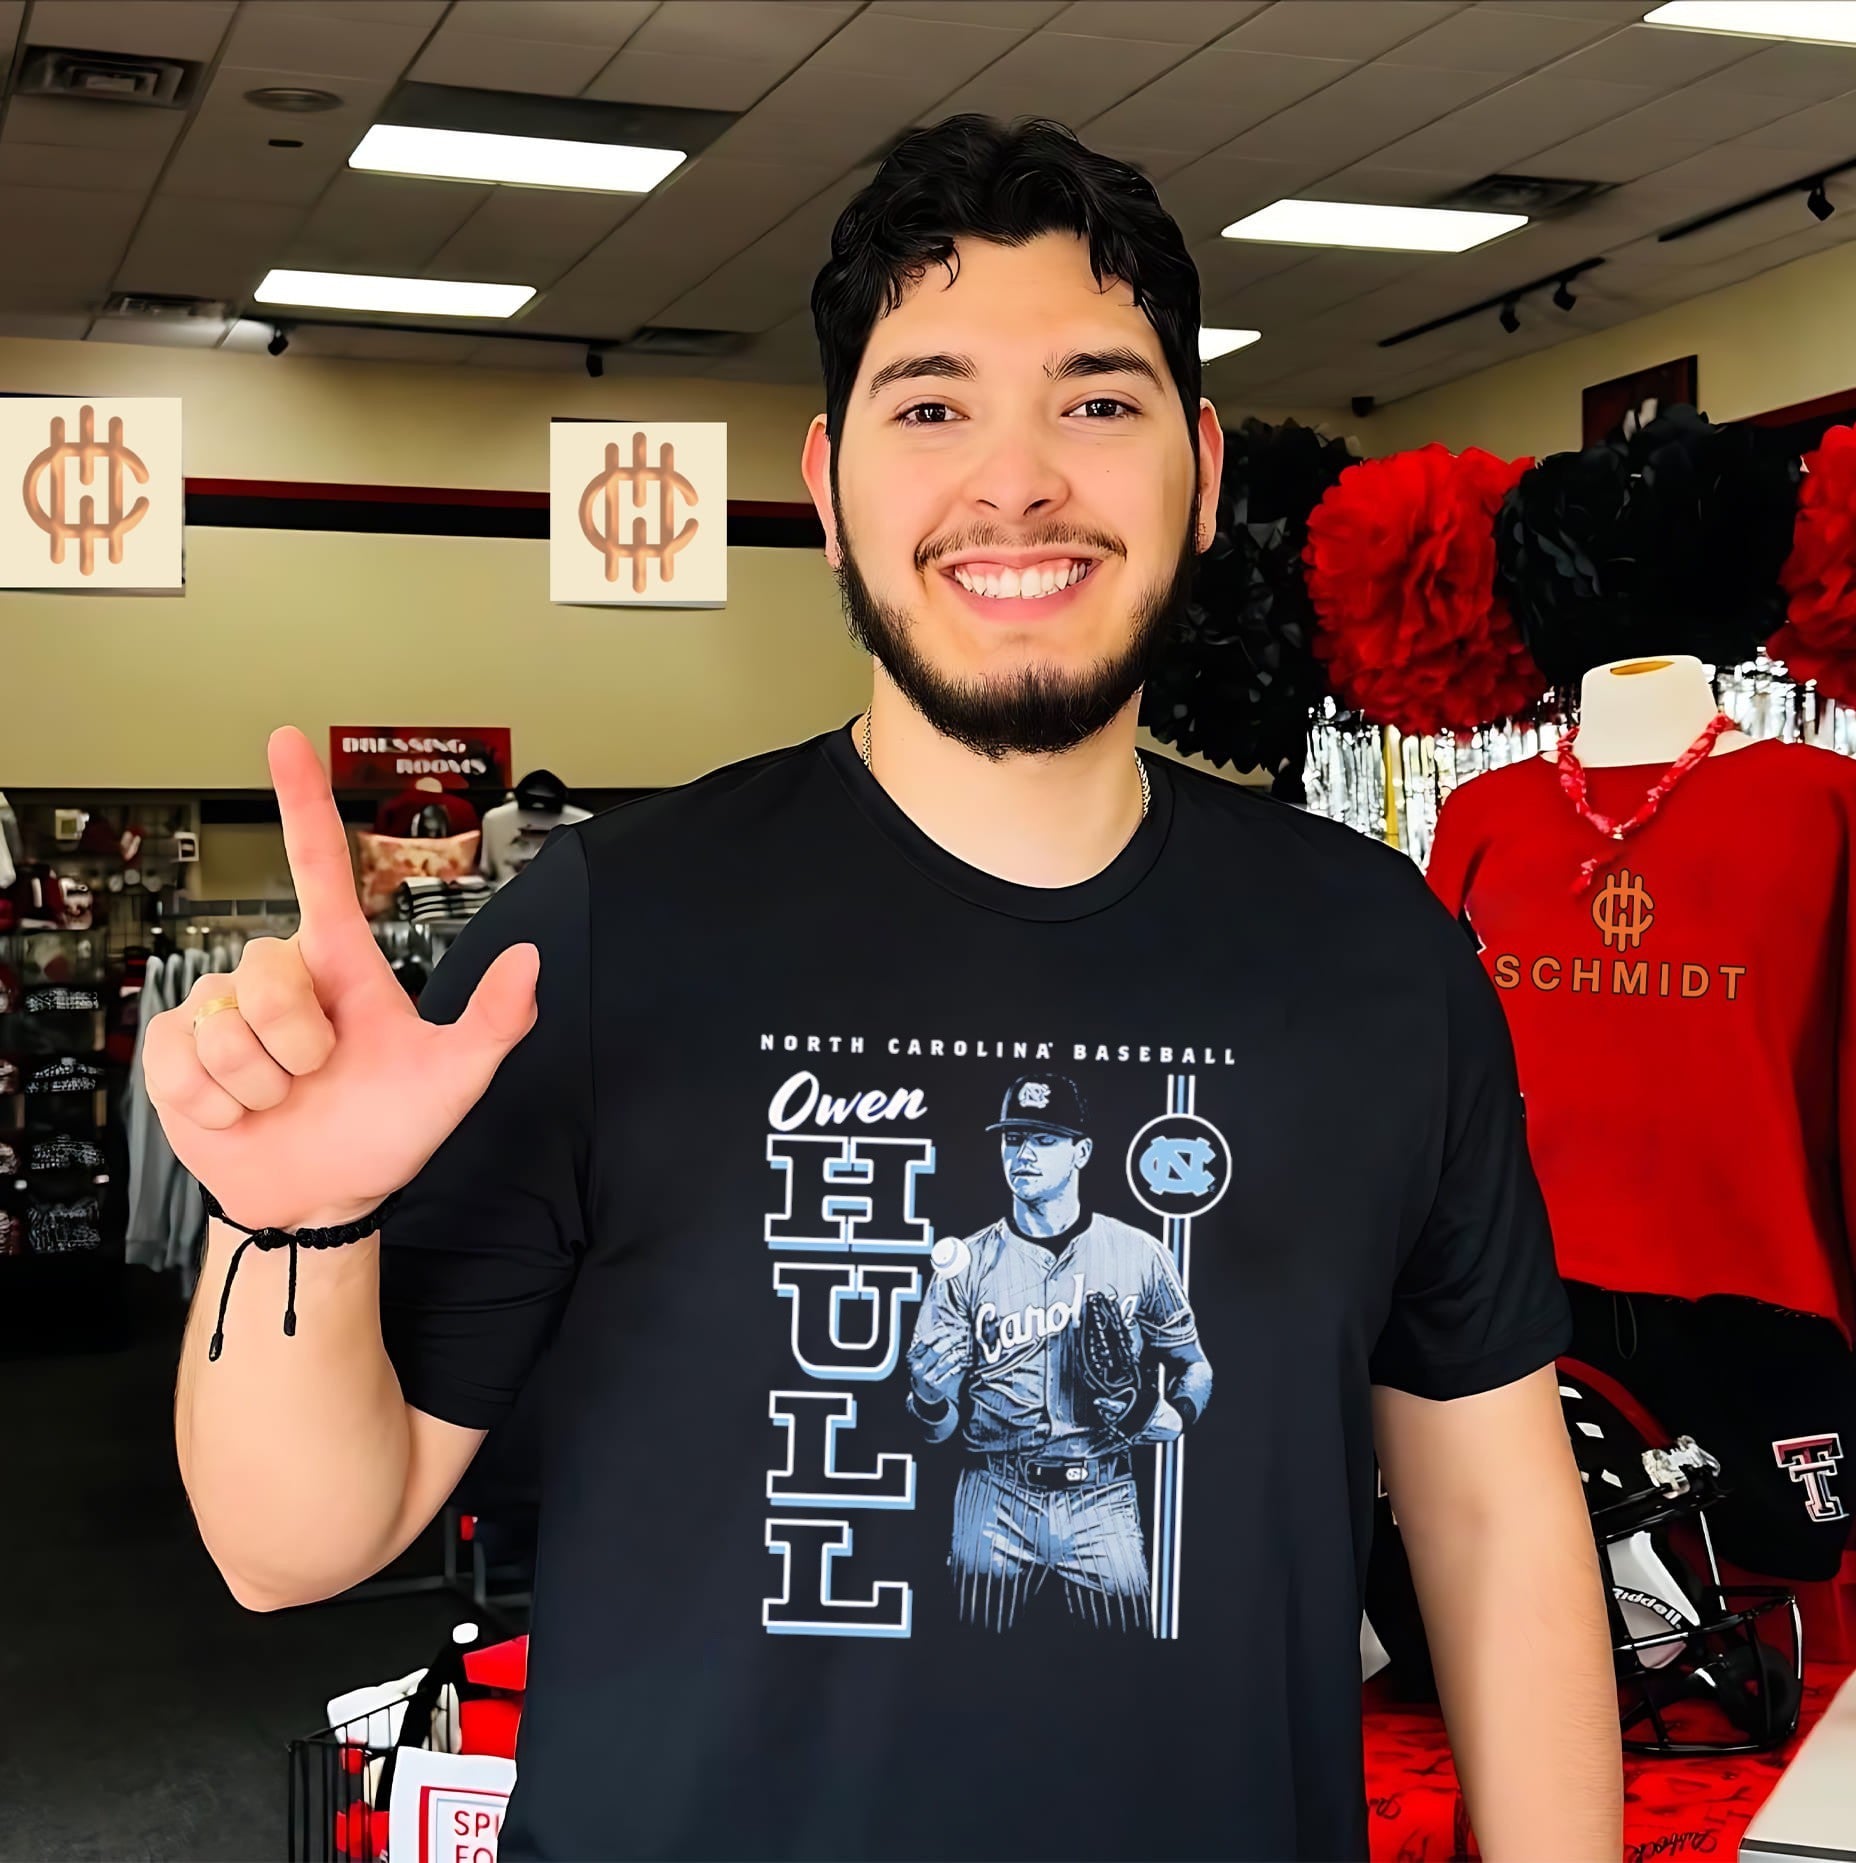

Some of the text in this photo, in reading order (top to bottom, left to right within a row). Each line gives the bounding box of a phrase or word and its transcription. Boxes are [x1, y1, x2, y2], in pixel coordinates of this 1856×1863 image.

[396, 757, 487, 775] ROOMS
[1494, 953, 1746, 1001] SCHMIDT
[760, 1033, 1236, 1066] NORTH CAROLINA BASEBALL
[767, 1070, 928, 1132] Owen
[763, 1132, 937, 1640] HULL
